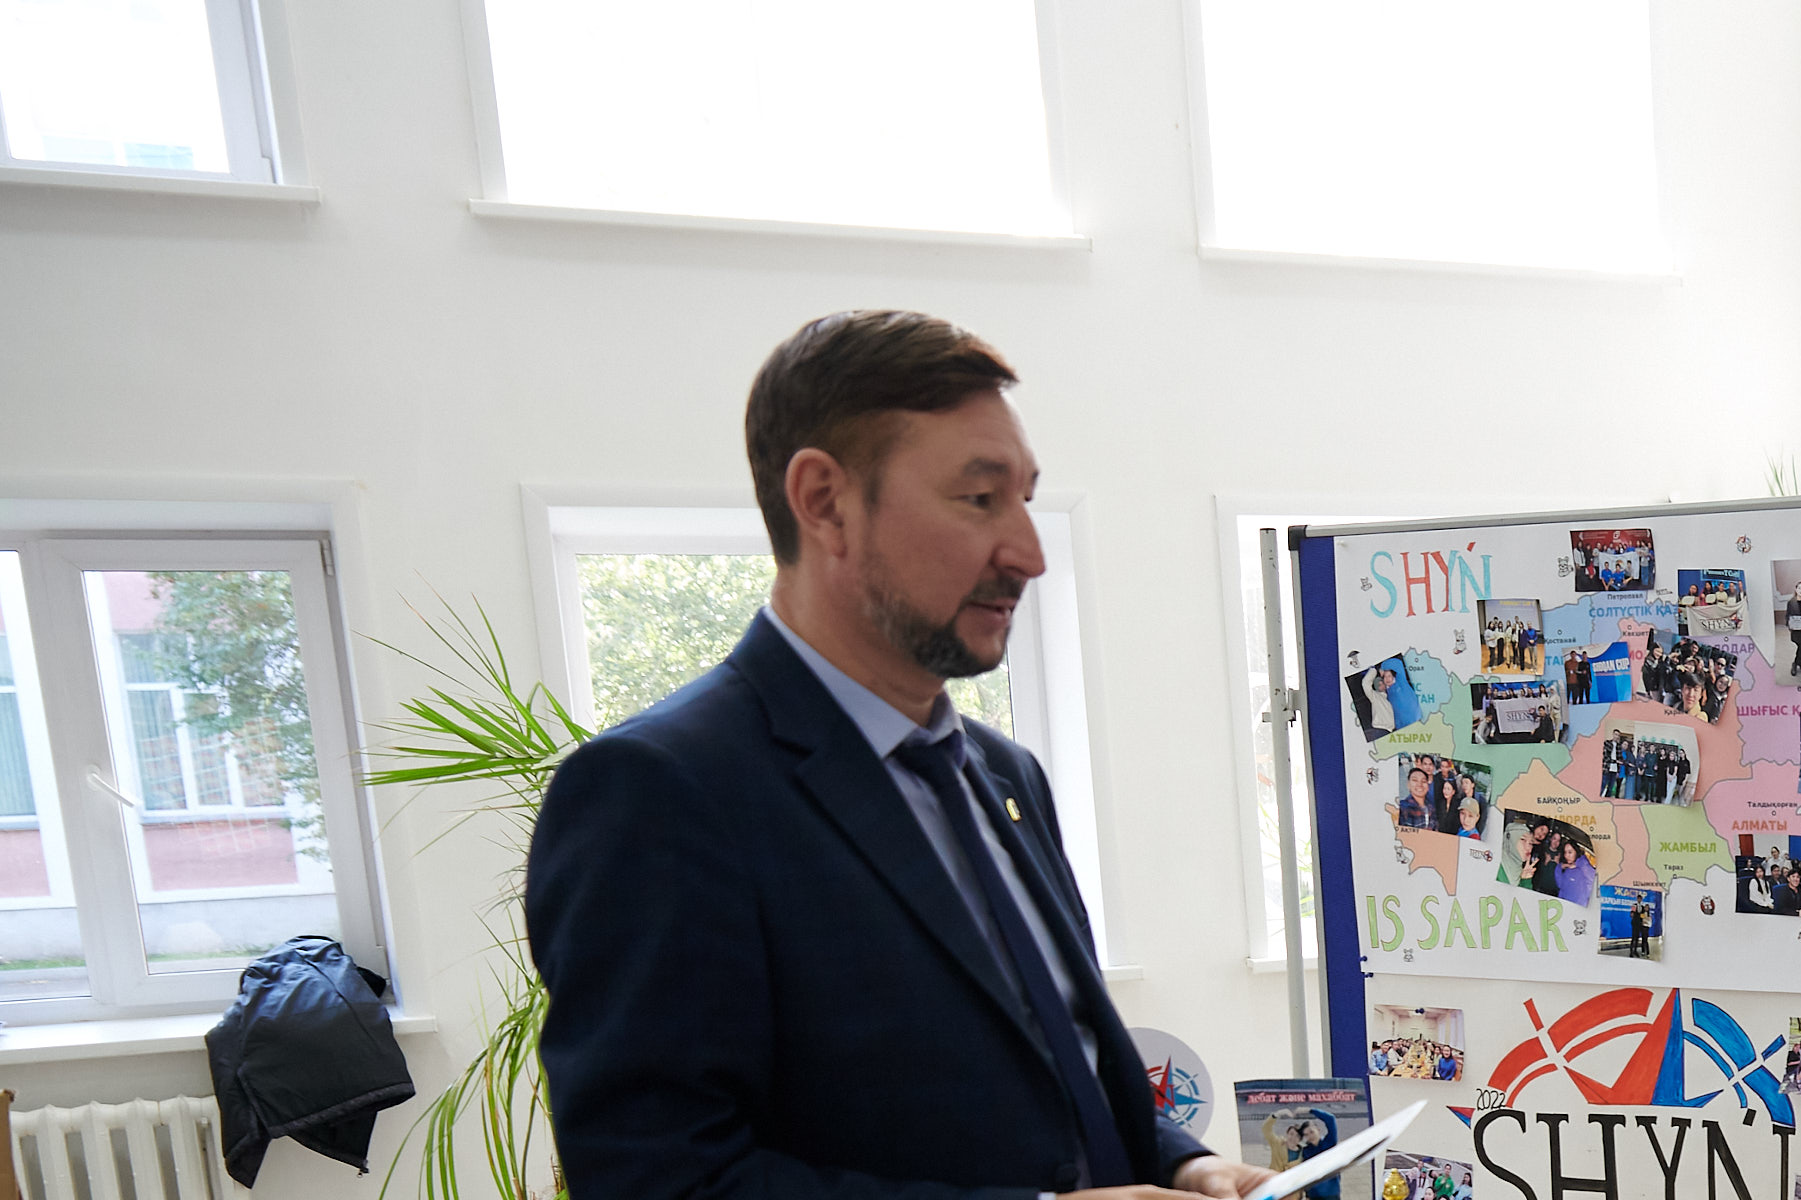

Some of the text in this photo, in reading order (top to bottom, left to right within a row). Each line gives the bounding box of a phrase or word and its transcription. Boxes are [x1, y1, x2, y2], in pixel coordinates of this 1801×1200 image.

[1389, 733, 1433, 744] АТЫРАУ
[1731, 820, 1788, 832] АЛМАТЫ
[1659, 841, 1717, 853] ЖАМБЫЛ
[1366, 894, 1569, 952] IS SAPAR
[1246, 1091, 1277, 1104] дебат
[1475, 1088, 1506, 1111] 2022
